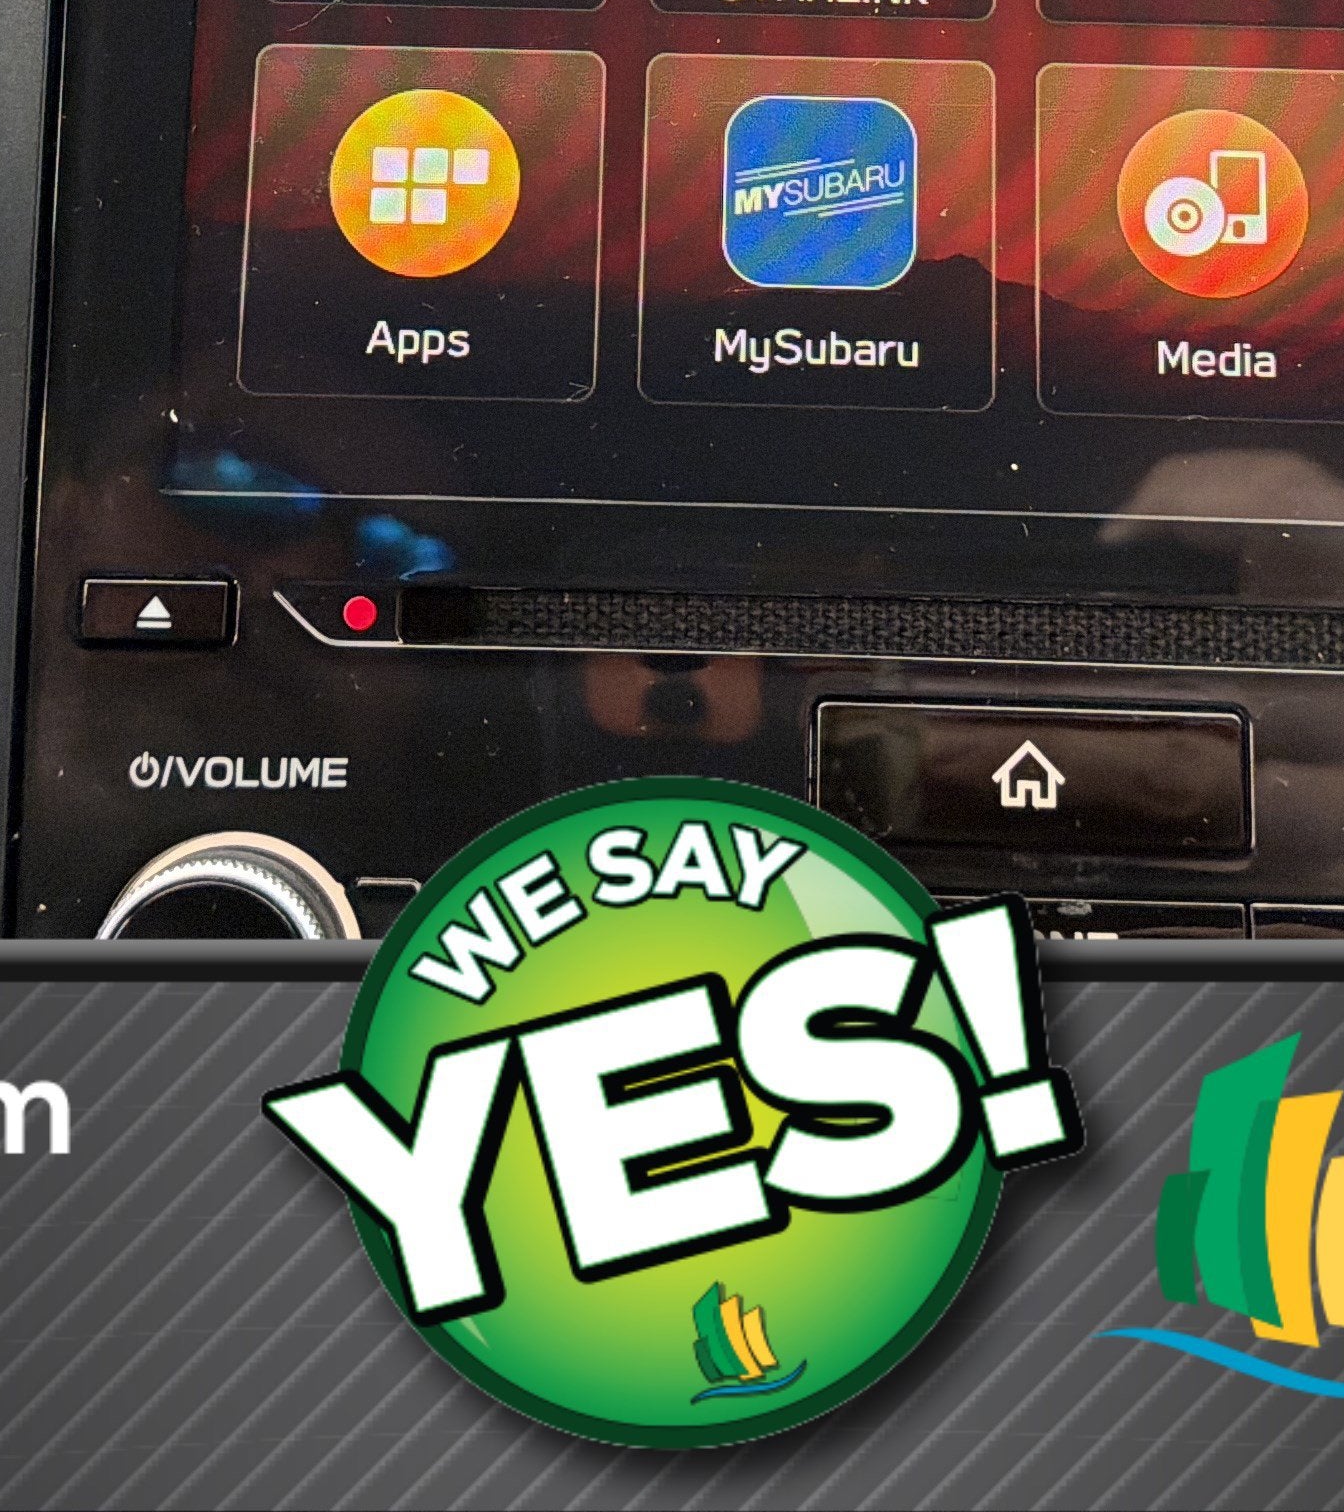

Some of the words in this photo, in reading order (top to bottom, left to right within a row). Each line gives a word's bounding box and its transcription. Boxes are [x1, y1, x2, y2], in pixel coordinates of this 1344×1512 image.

[734, 159, 906, 216] MYSUBARU
[365, 320, 471, 365] Apps
[714, 328, 920, 373] MySubaru
[1157, 340, 1278, 379] Media
